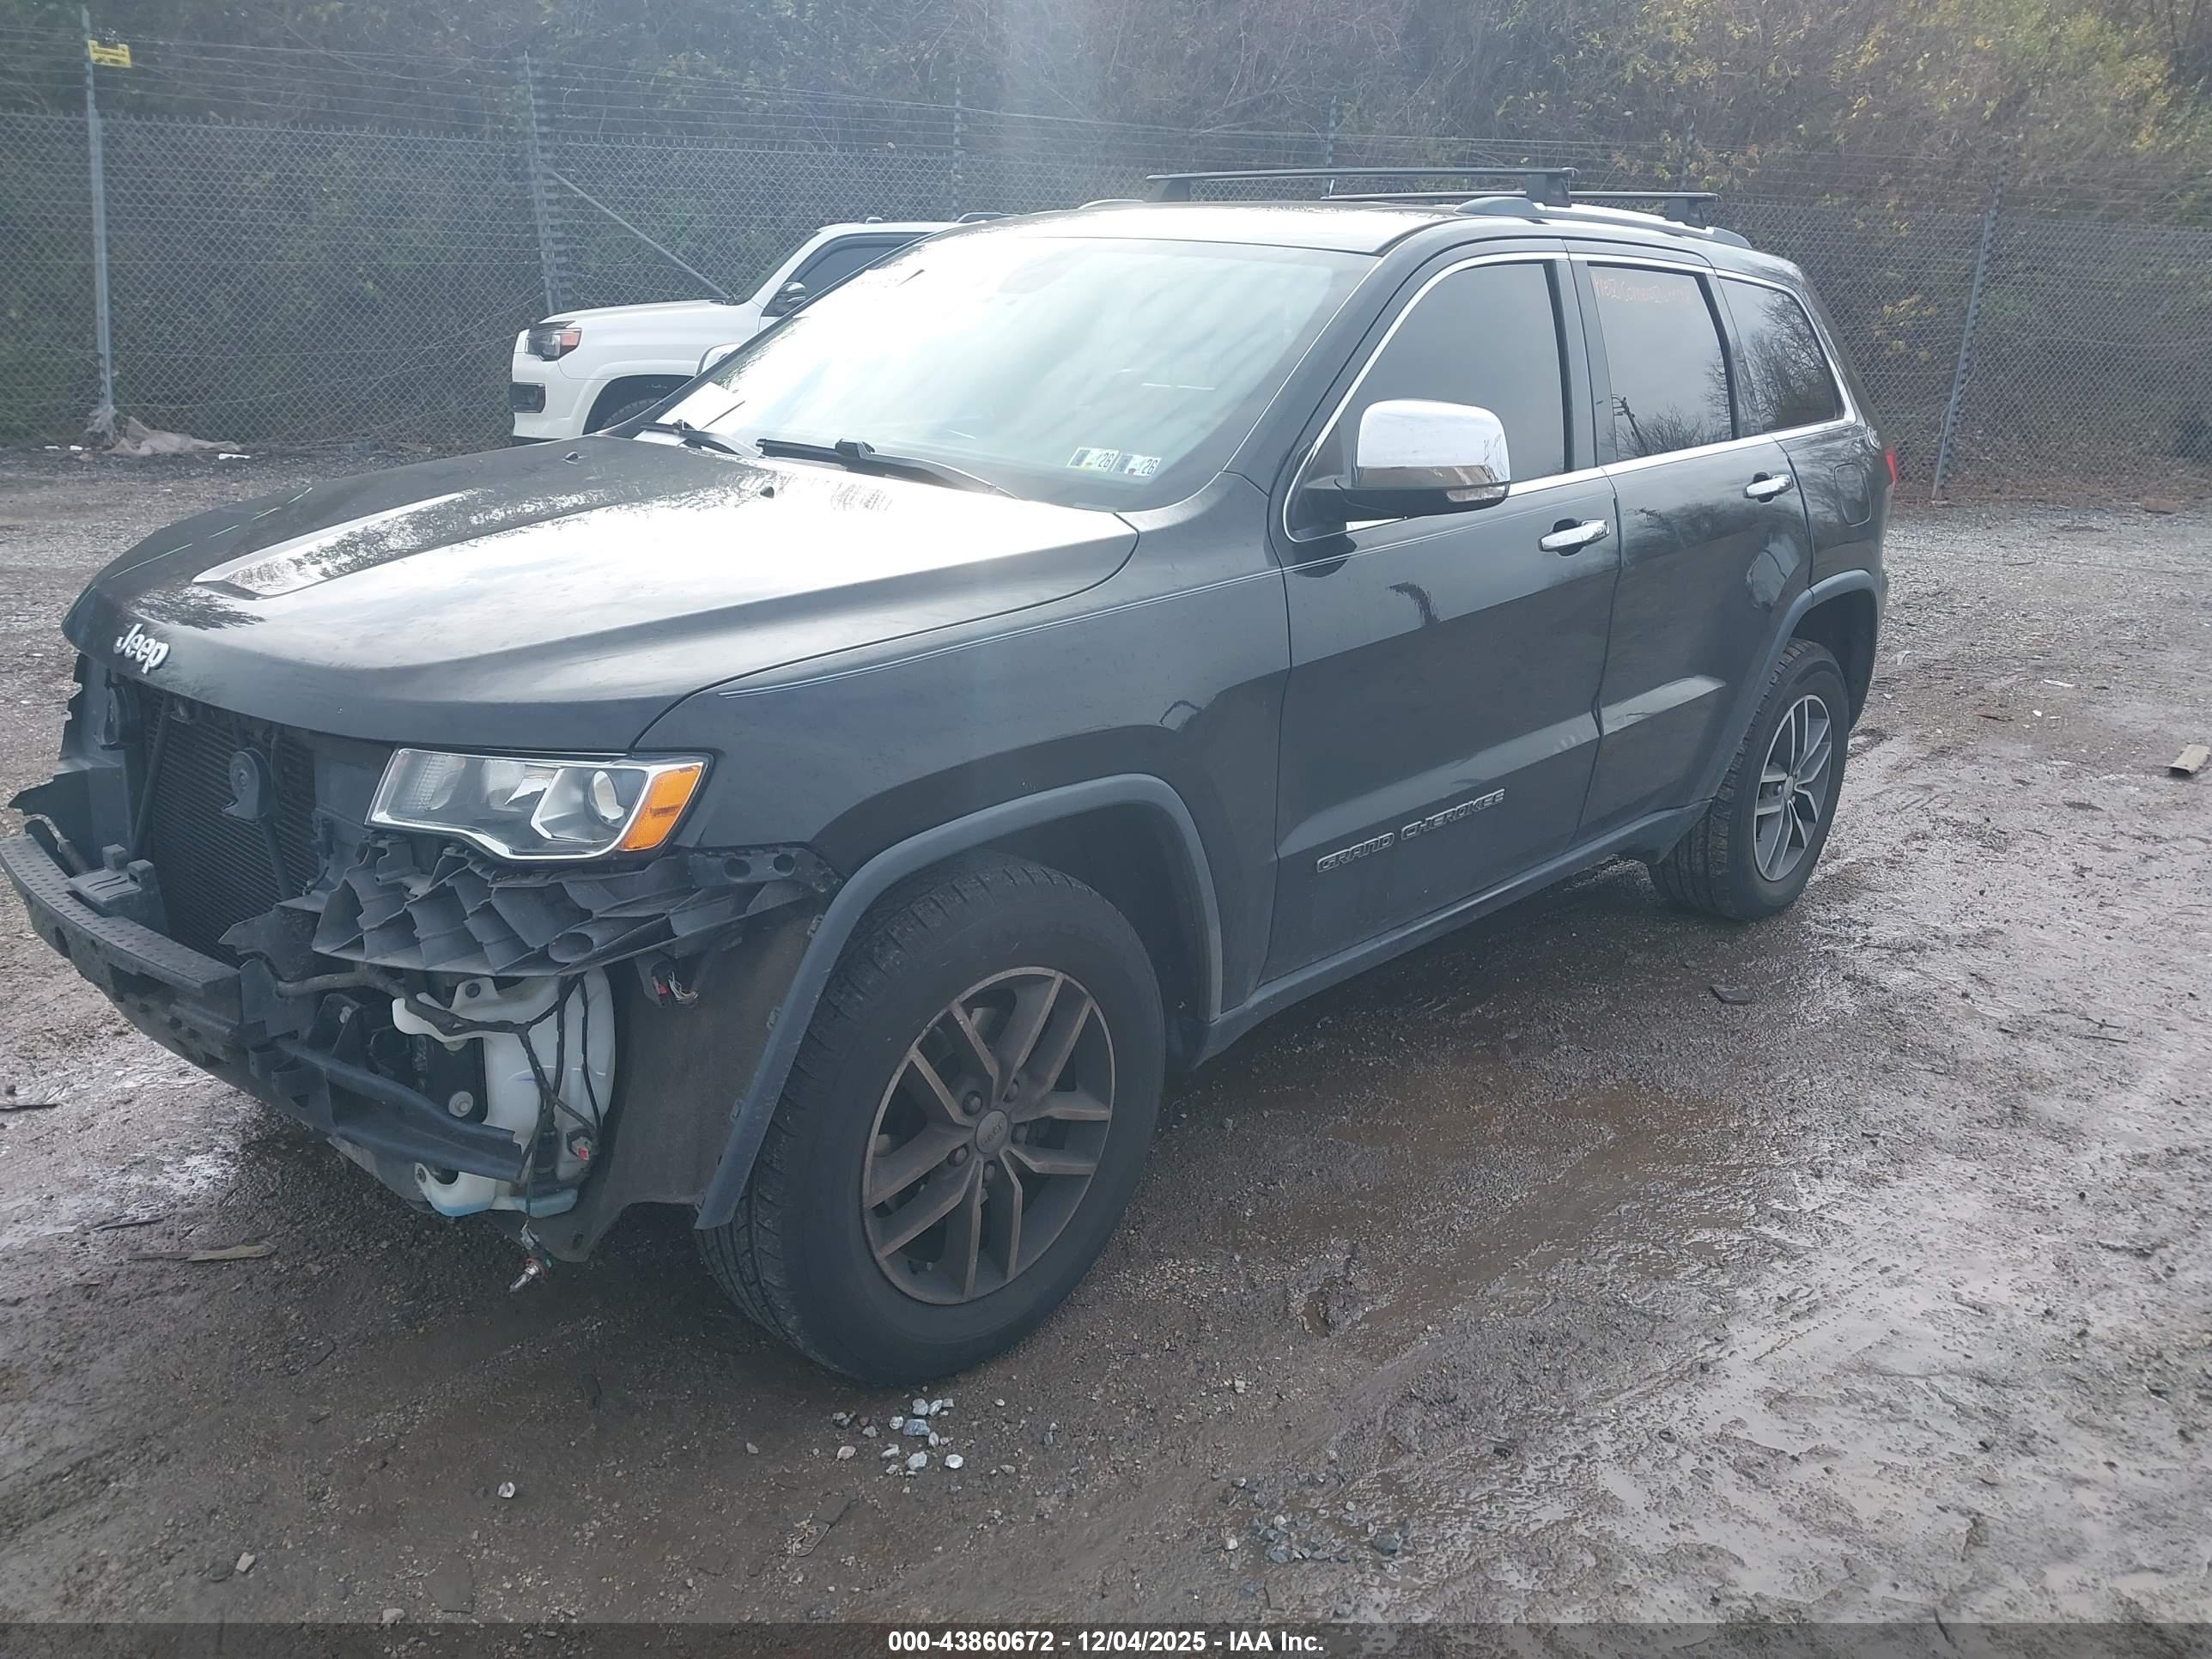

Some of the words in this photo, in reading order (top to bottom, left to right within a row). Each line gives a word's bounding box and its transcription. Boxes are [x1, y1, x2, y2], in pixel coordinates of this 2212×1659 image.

[113, 623, 170, 674] Jeep
[1317, 831, 1395, 873] GRAND
[1401, 788, 1505, 841] CHEROKEE
